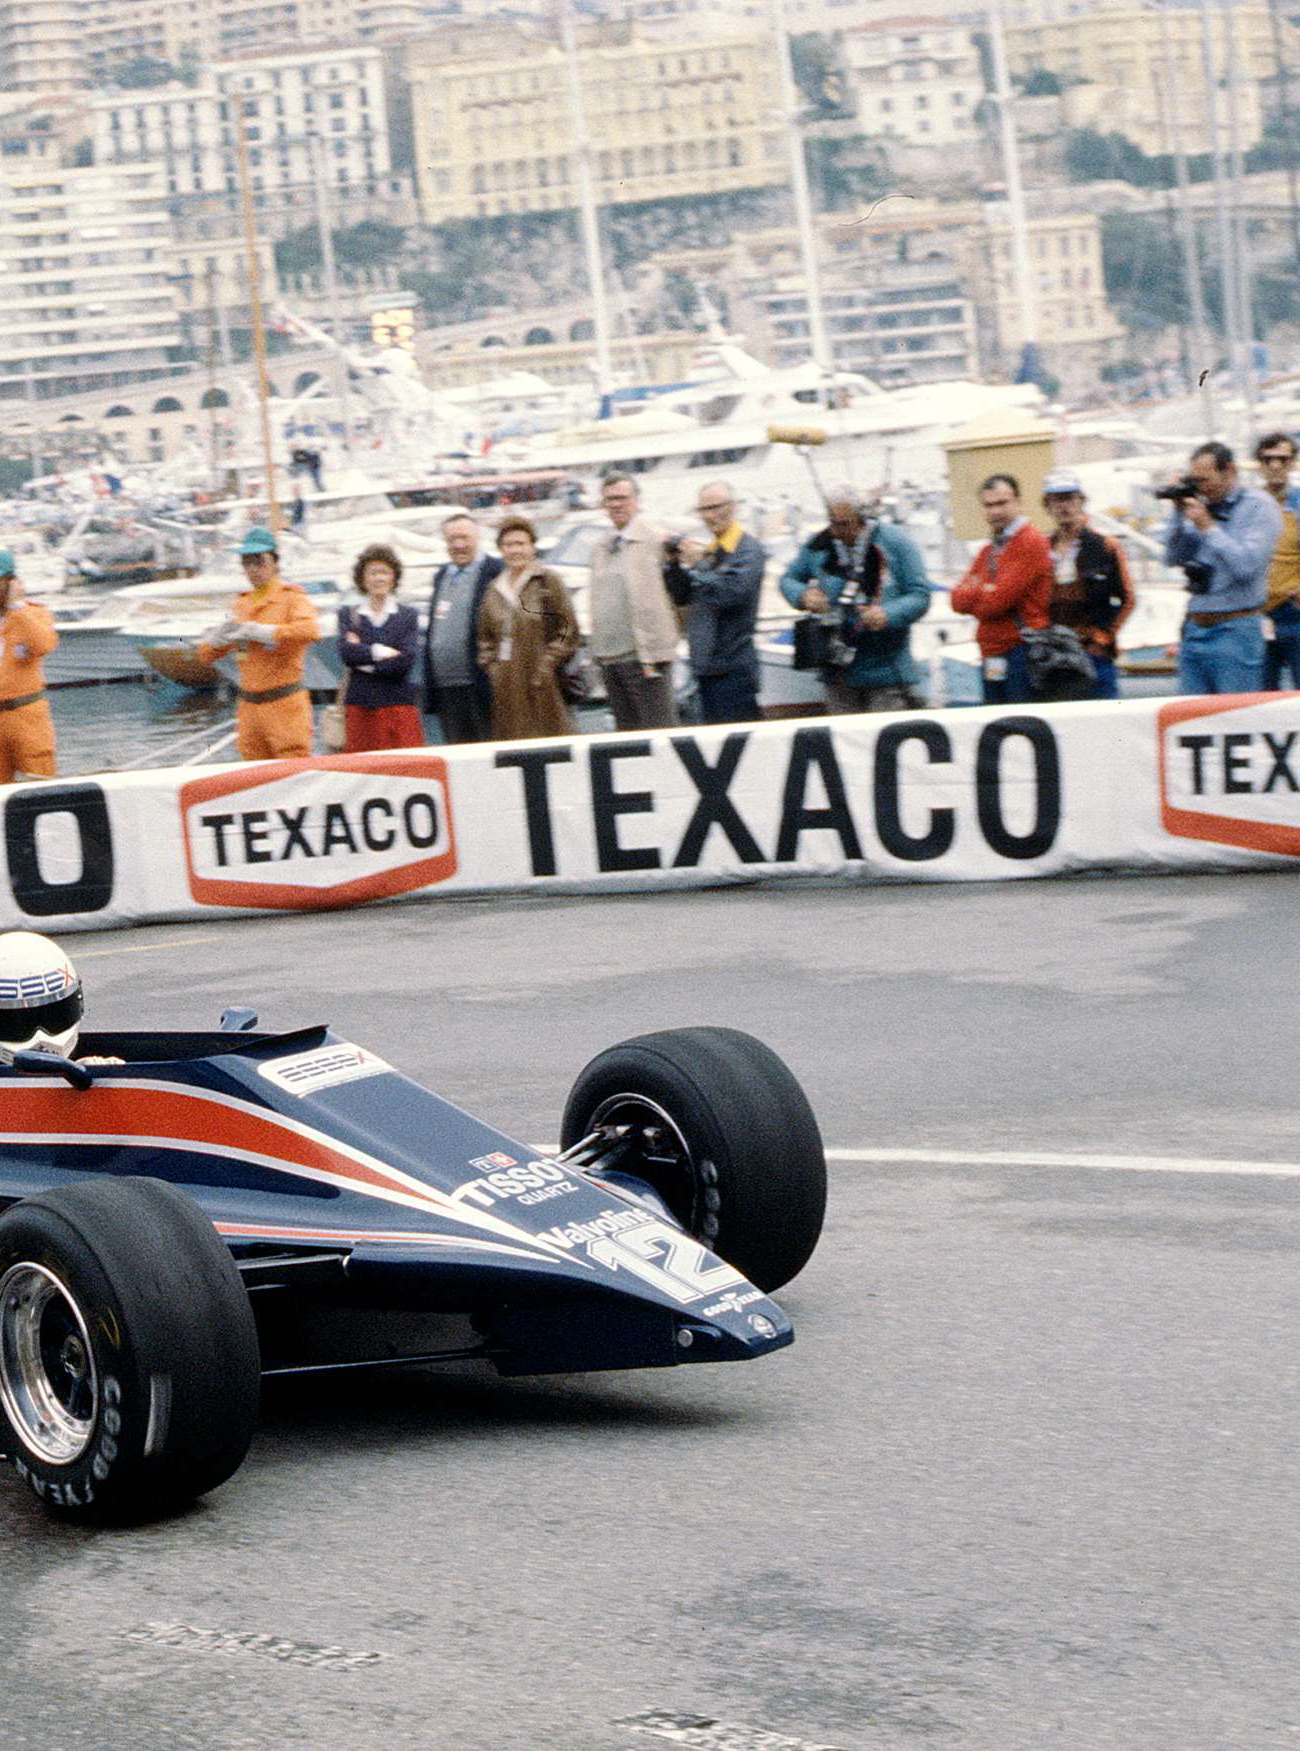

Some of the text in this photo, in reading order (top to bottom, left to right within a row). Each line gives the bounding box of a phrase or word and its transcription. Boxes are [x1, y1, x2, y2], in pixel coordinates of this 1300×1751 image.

[494, 715, 1061, 877] TEXACO
[1178, 730, 1300, 795] TEX
[201, 792, 439, 867] TEXACO
[517, 1181, 580, 1207] QUARTZ
[586, 1220, 748, 1304] 12
